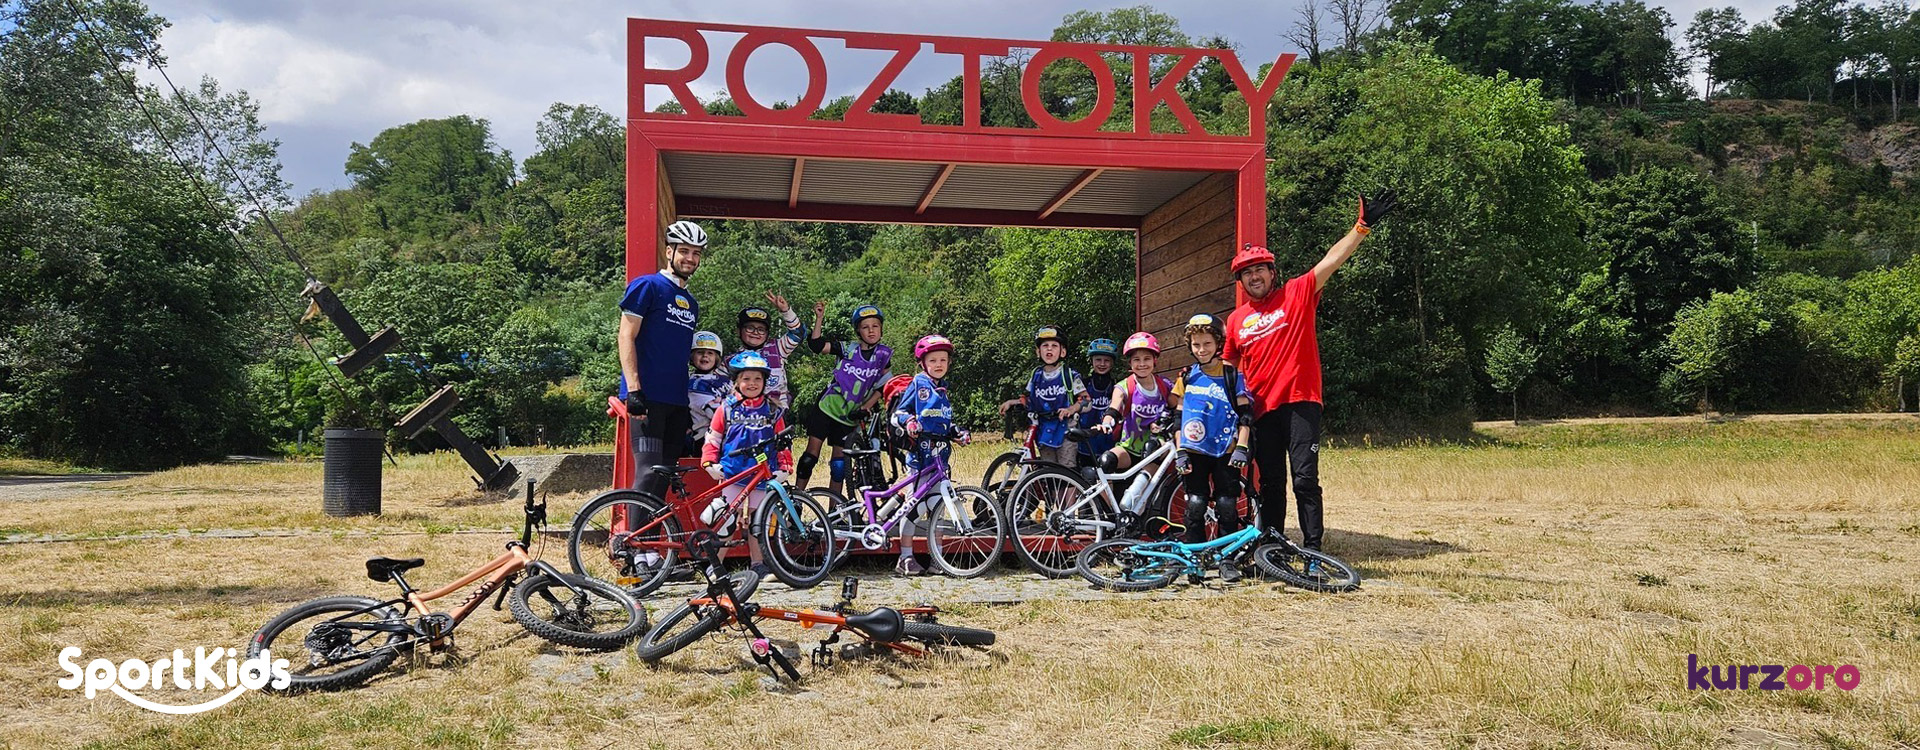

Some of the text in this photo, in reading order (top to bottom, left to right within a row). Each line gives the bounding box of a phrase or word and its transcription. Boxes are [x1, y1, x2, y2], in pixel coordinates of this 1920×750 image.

[628, 18, 1297, 138] ROZTOKY
[1238, 309, 1285, 339] SportKids
[888, 497, 918, 522] woom
[457, 581, 496, 607] woom
